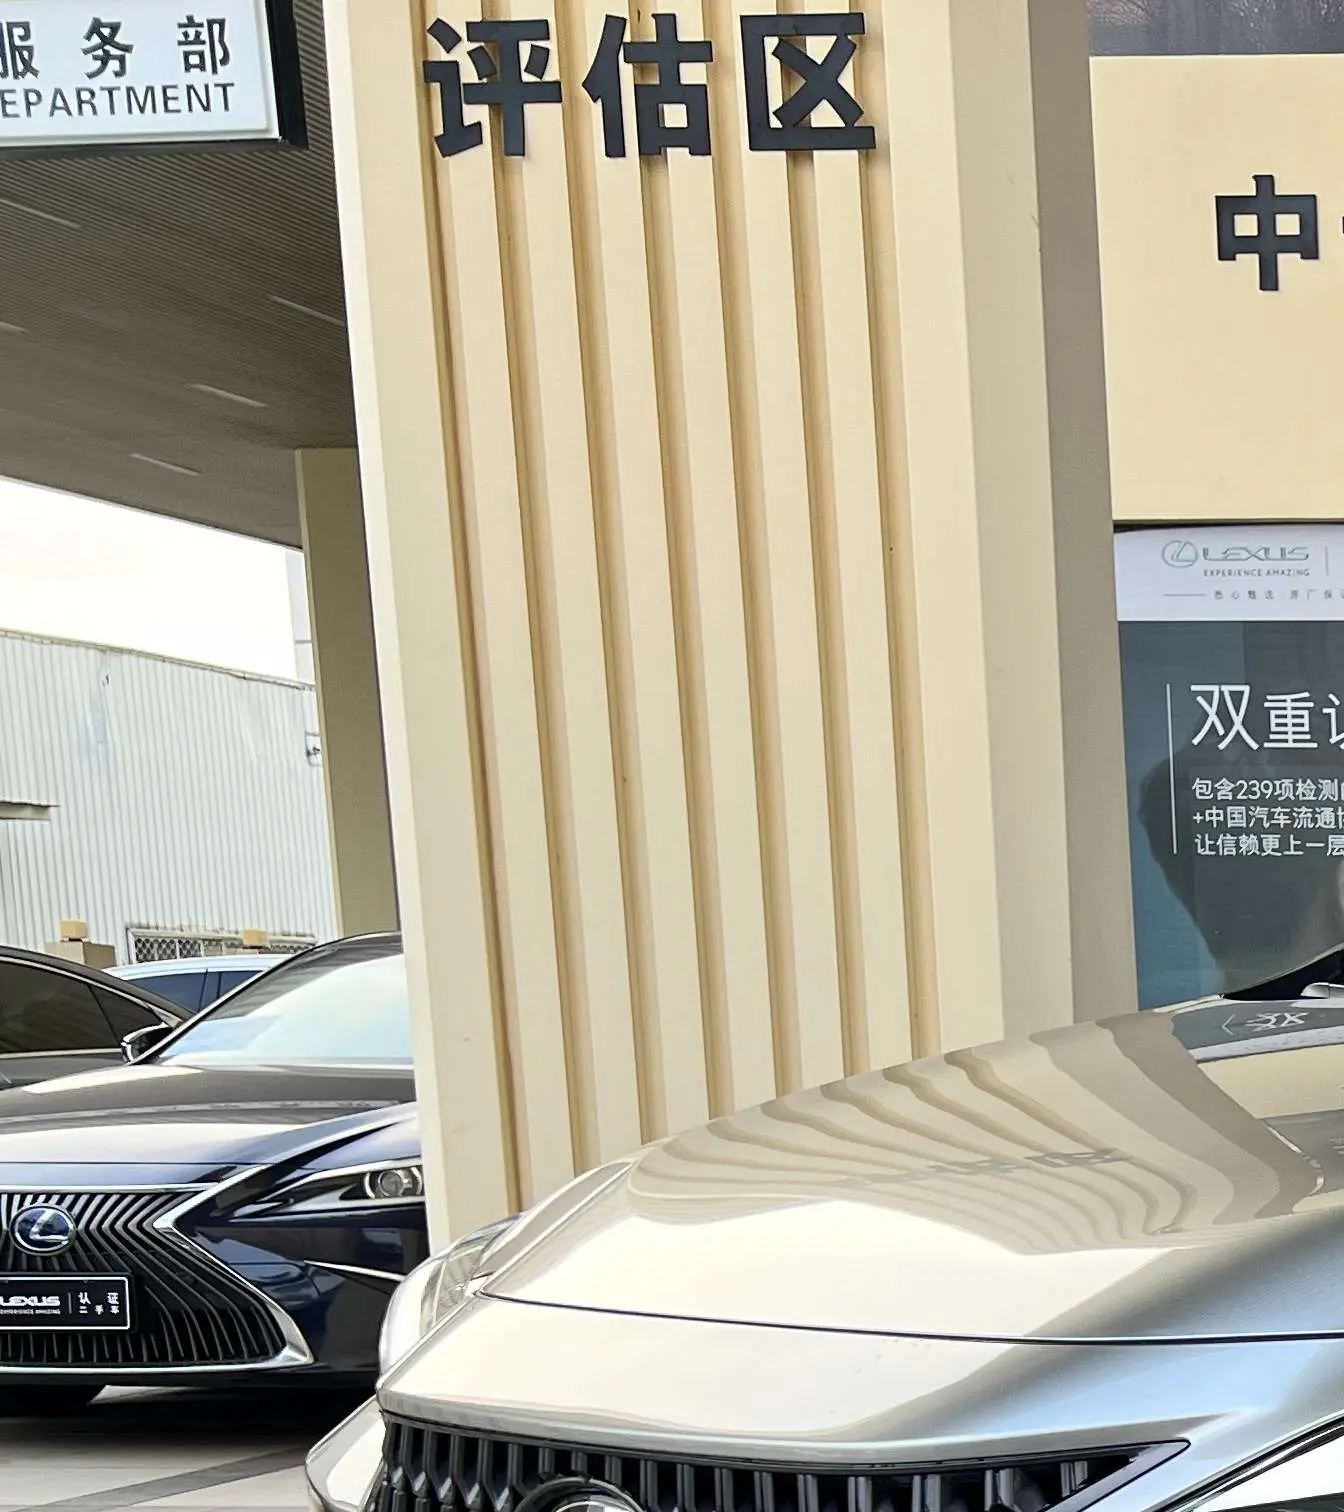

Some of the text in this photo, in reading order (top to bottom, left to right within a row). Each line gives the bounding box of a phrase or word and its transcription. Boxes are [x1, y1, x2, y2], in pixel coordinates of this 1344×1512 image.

[423, 13, 876, 158] 评估区
[1202, 546, 1310, 562] LEXUS
[1203, 568, 1310, 578] EXPERIENCE AMAZING
